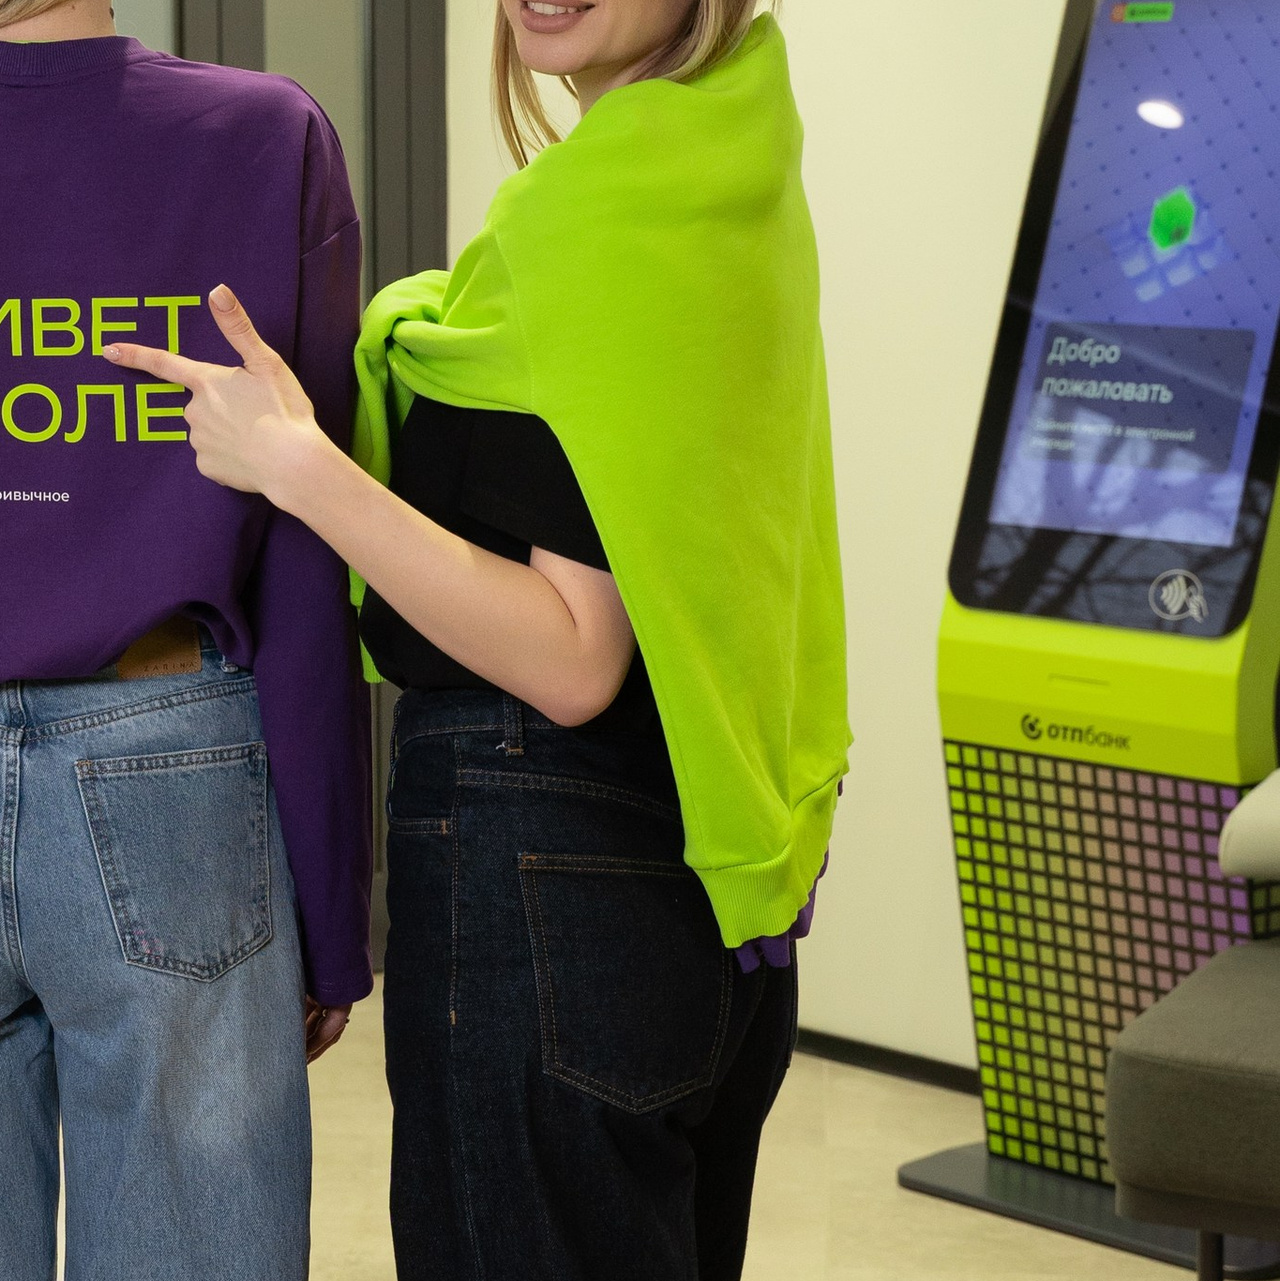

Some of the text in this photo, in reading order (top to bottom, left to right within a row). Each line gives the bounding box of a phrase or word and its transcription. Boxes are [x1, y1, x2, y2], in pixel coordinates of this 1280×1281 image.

[1047, 337, 1121, 367] Добро
[1042, 377, 1173, 404] пожаловать
[1047, 723, 1130, 750] отпбанк
